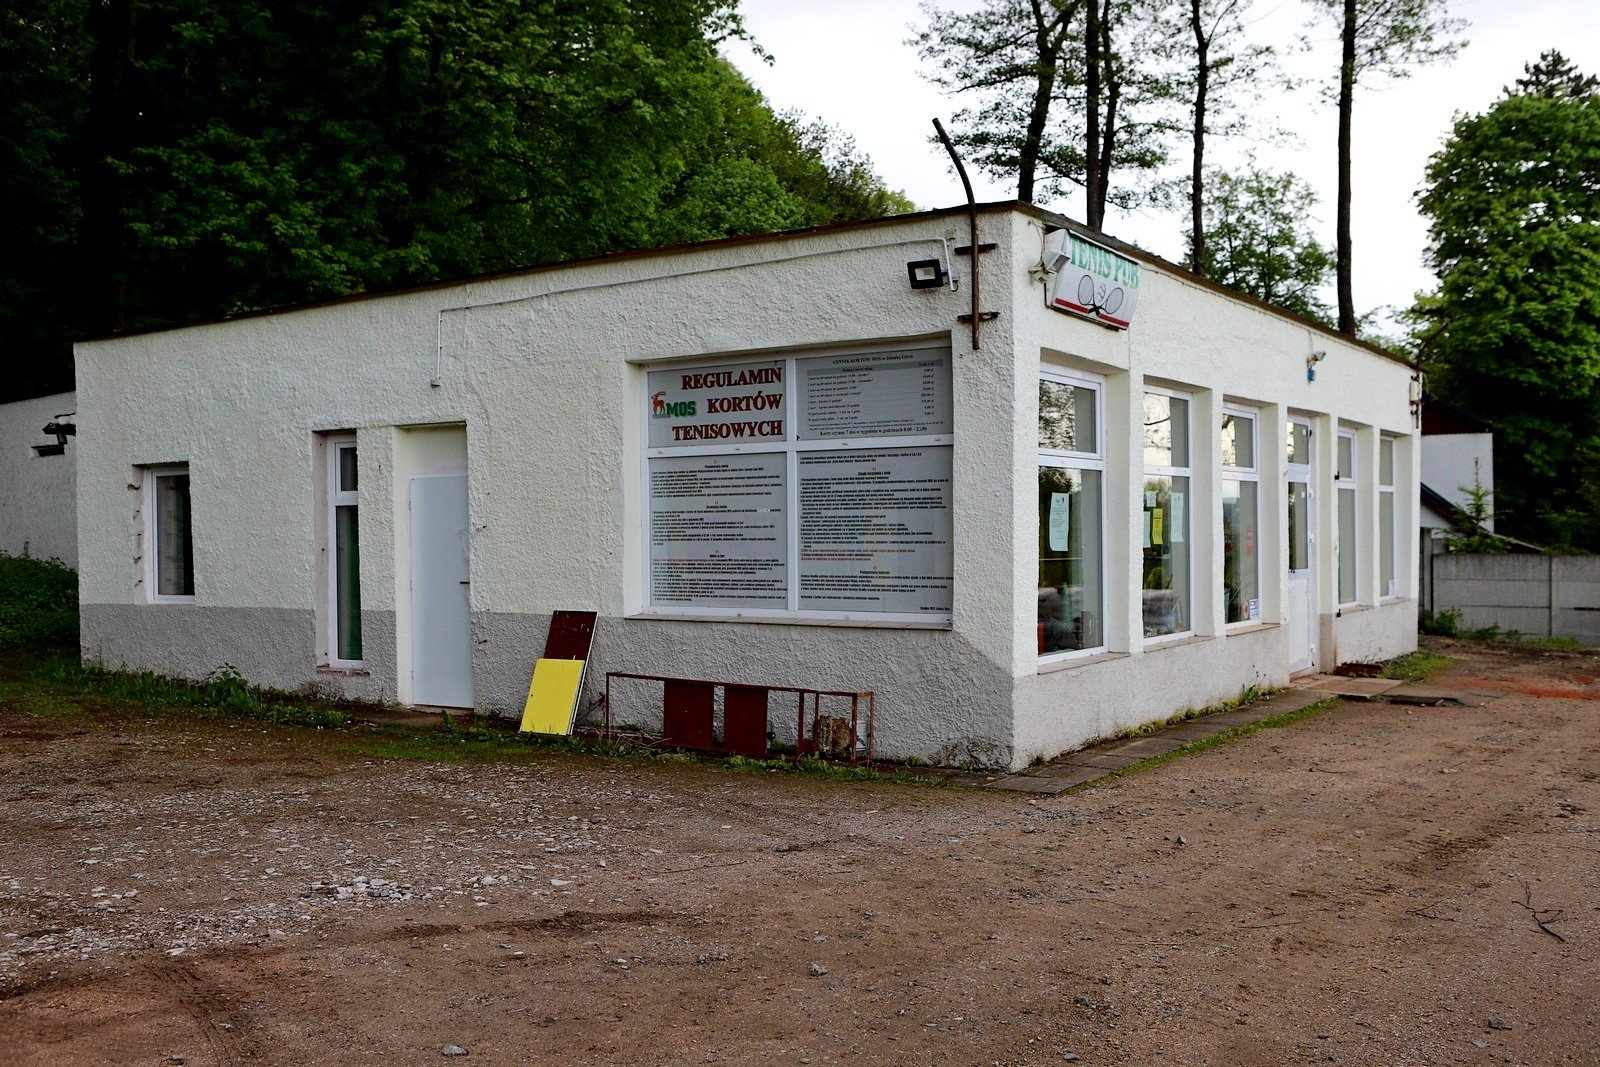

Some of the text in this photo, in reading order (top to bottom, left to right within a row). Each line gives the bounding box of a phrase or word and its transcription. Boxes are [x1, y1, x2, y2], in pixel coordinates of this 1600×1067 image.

[1068, 236, 1140, 289] TENIS PUB
[681, 367, 783, 390] REGULAMIN
[666, 400, 697, 417] MOS
[707, 390, 783, 413] KORTÓW
[672, 420, 783, 440] TENISOWYCH
